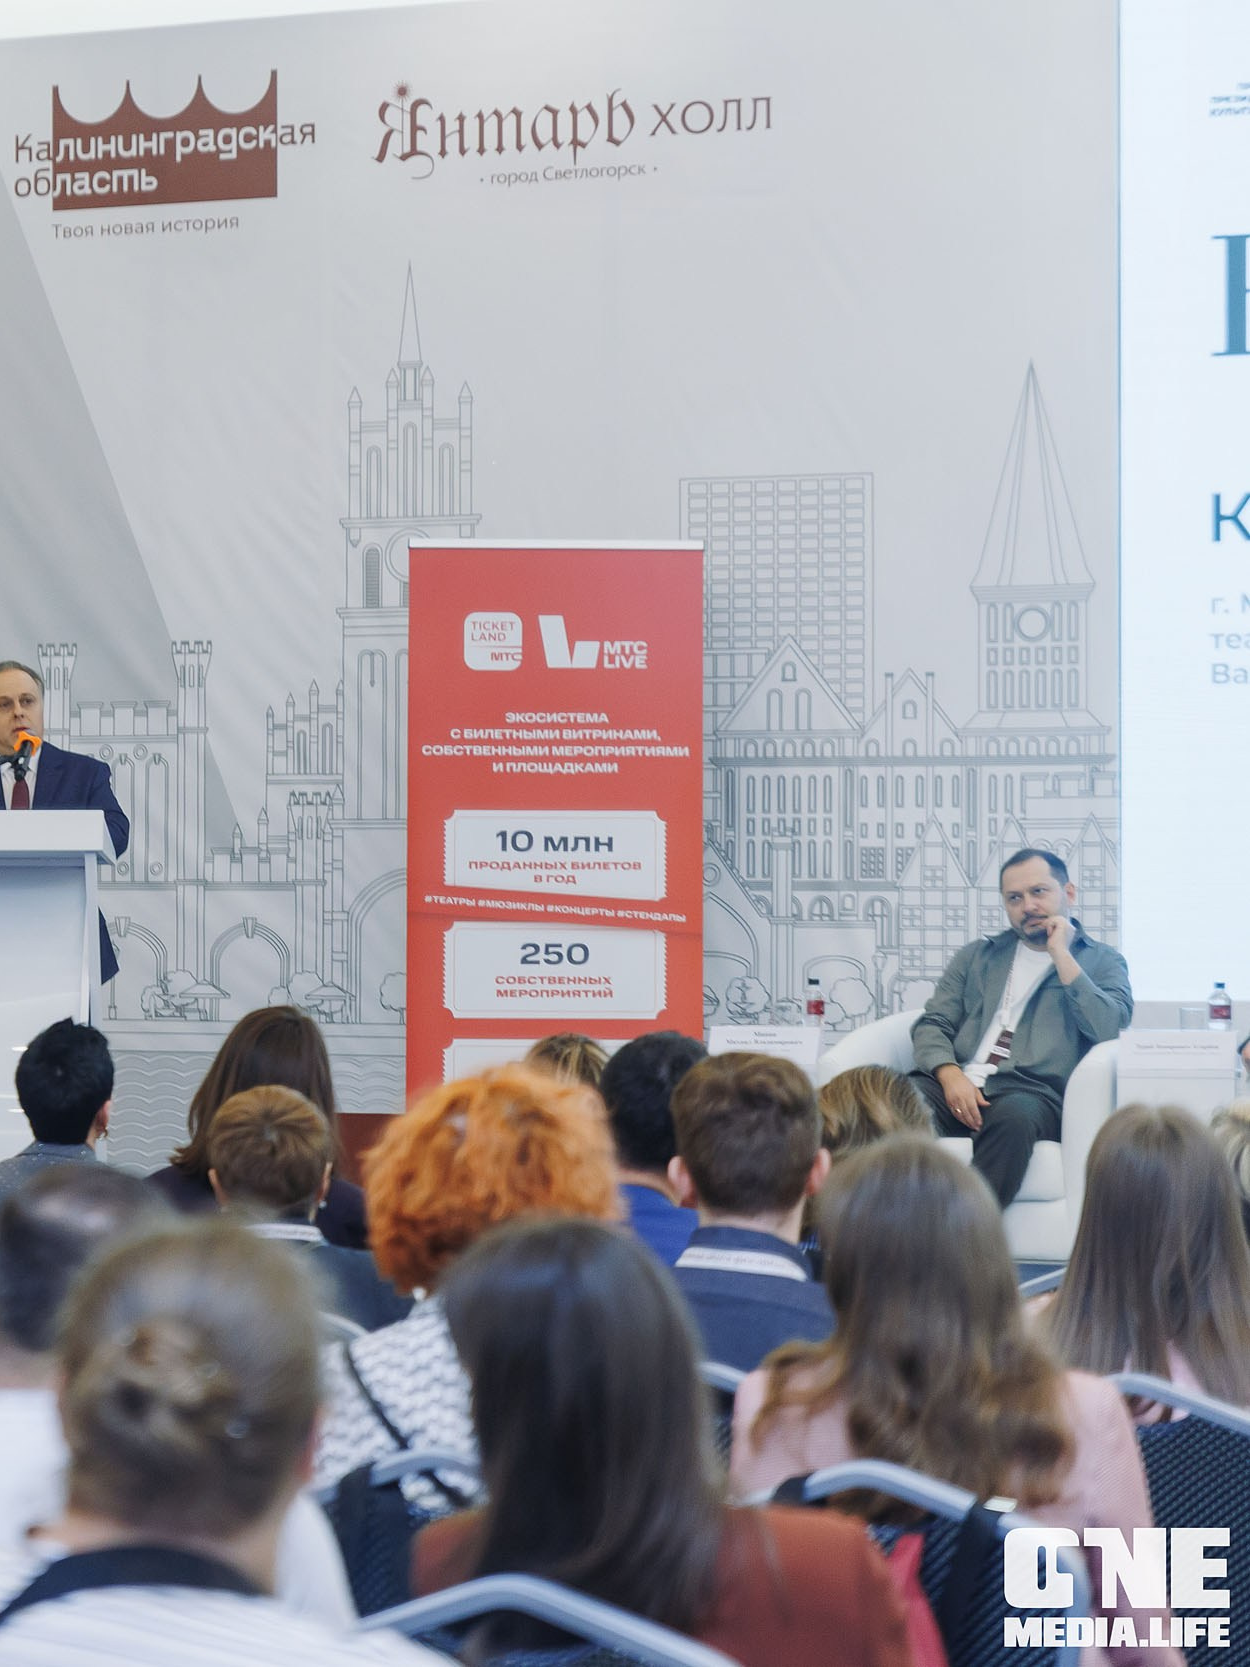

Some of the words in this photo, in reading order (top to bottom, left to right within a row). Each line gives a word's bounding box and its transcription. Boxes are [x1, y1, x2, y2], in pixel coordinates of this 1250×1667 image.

[15, 122, 316, 163] Калининградская
[490, 172, 539, 186] город
[543, 163, 646, 181] Светлогорск
[15, 168, 158, 197] область
[52, 223, 94, 239] Твоя
[101, 220, 155, 237] новая
[162, 216, 239, 234] история
[471, 621, 515, 631] TICKET
[471, 632, 507, 642] LAND
[604, 655, 647, 669] LIVE
[505, 712, 609, 723] ЭКОСИСТЕМА
[450, 729, 460, 739] С
[464, 729, 560, 740] БИЛЕТНЫМИ
[563, 729, 661, 741] ВИТРИНАМИ,
[422, 745, 549, 756] СОБСТВЕННЫМИ
[552, 746, 689, 757] МЕРОПРИЯТИЯМИ
[493, 762, 503, 773] И
[506, 762, 618, 774] ПЛОЩАДКАМИ
[496, 830, 534, 852] 10
[469, 861, 567, 871] ПРОДАННЫХ
[571, 861, 642, 870] БИЛЕТОВ
[534, 874, 542, 883] В
[546, 874, 577, 885] ГОД
[424, 895, 475, 907] #ТЕАТРЫ
[478, 899, 544, 912] #МЮЗИКЛЫ
[547, 904, 615, 917] #КОНЦЕРТЫ
[520, 943, 589, 965] 250
[495, 976, 612, 986] СОБСТВЕННЫХ
[496, 988, 613, 999] МЕРОПРИЯТИЙ
